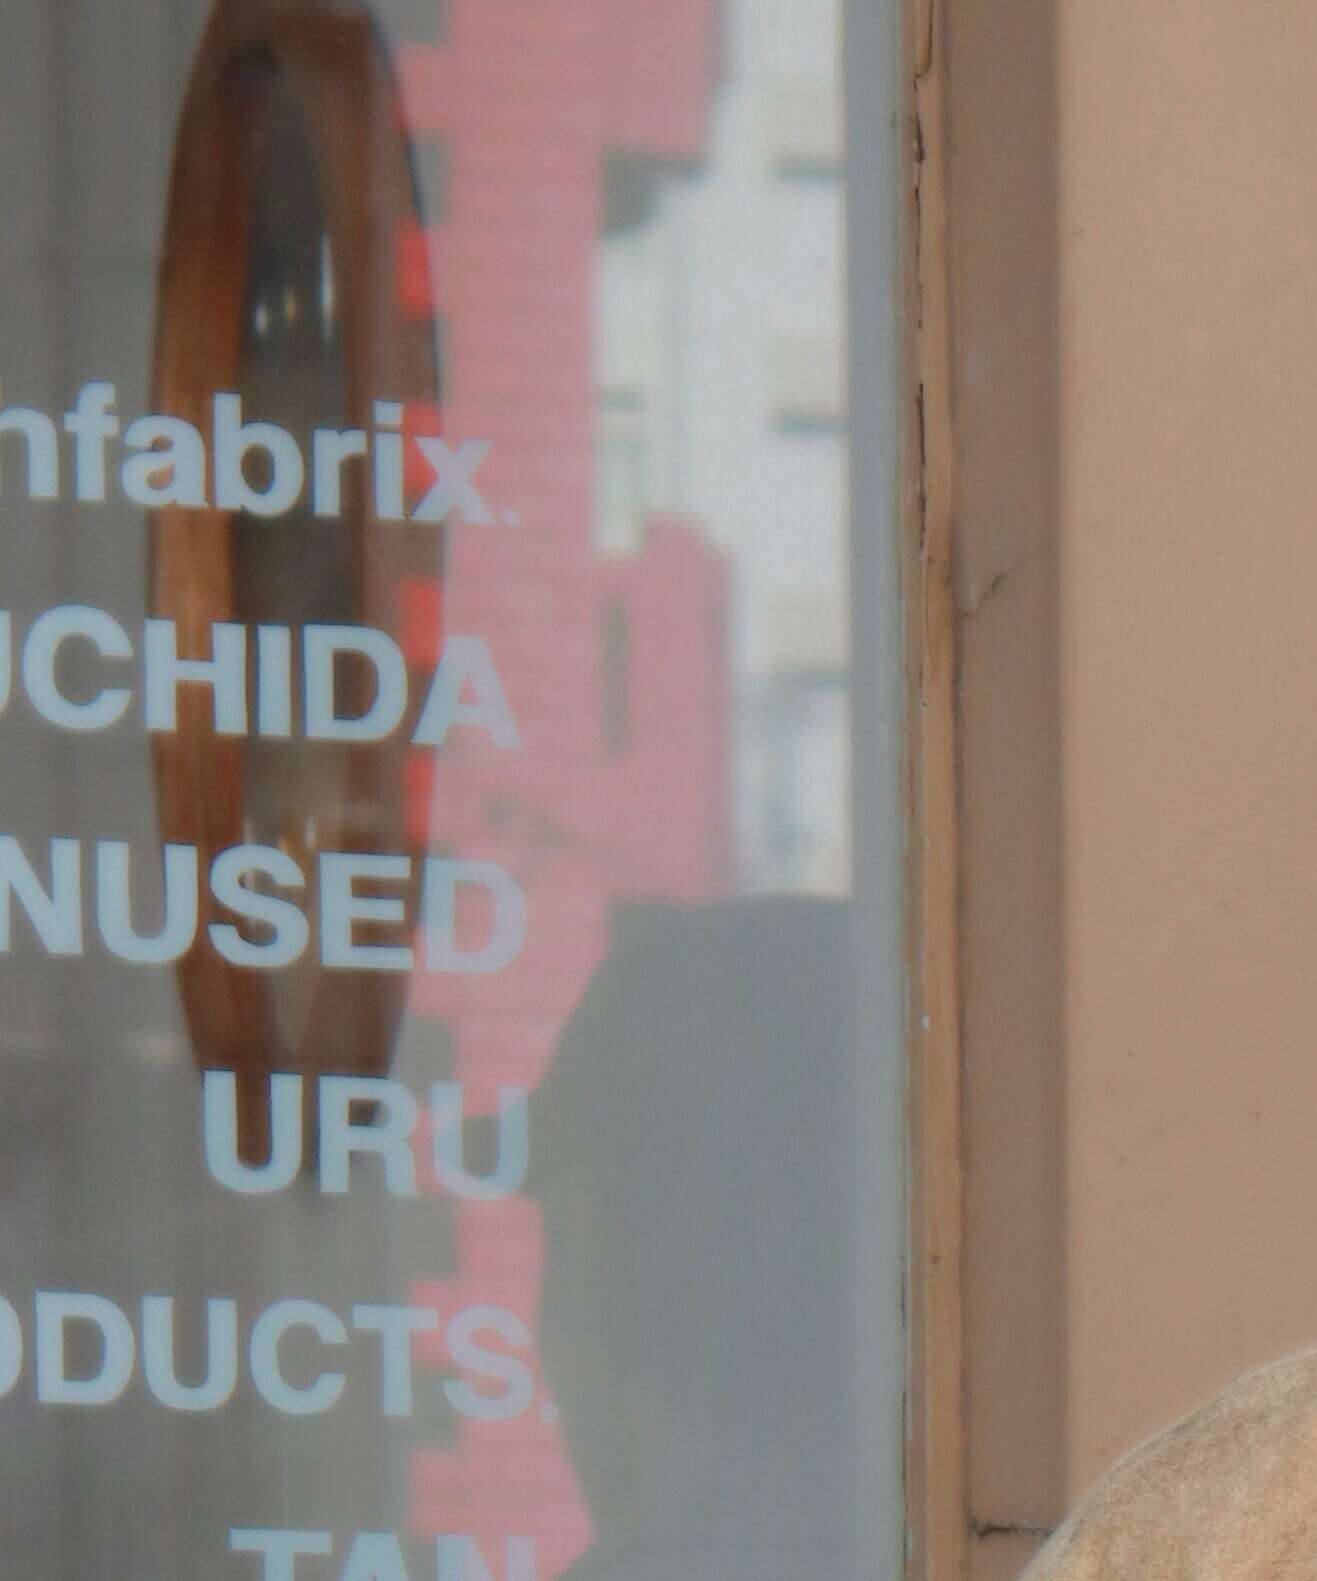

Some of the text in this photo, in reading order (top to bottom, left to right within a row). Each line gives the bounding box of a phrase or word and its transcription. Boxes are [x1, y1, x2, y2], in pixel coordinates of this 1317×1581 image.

[0, 605, 521, 750] CHIDA
[0, 836, 527, 974] NUSED
[204, 1069, 529, 1198] URU
[0, 1290, 560, 1424] DUCTS.
